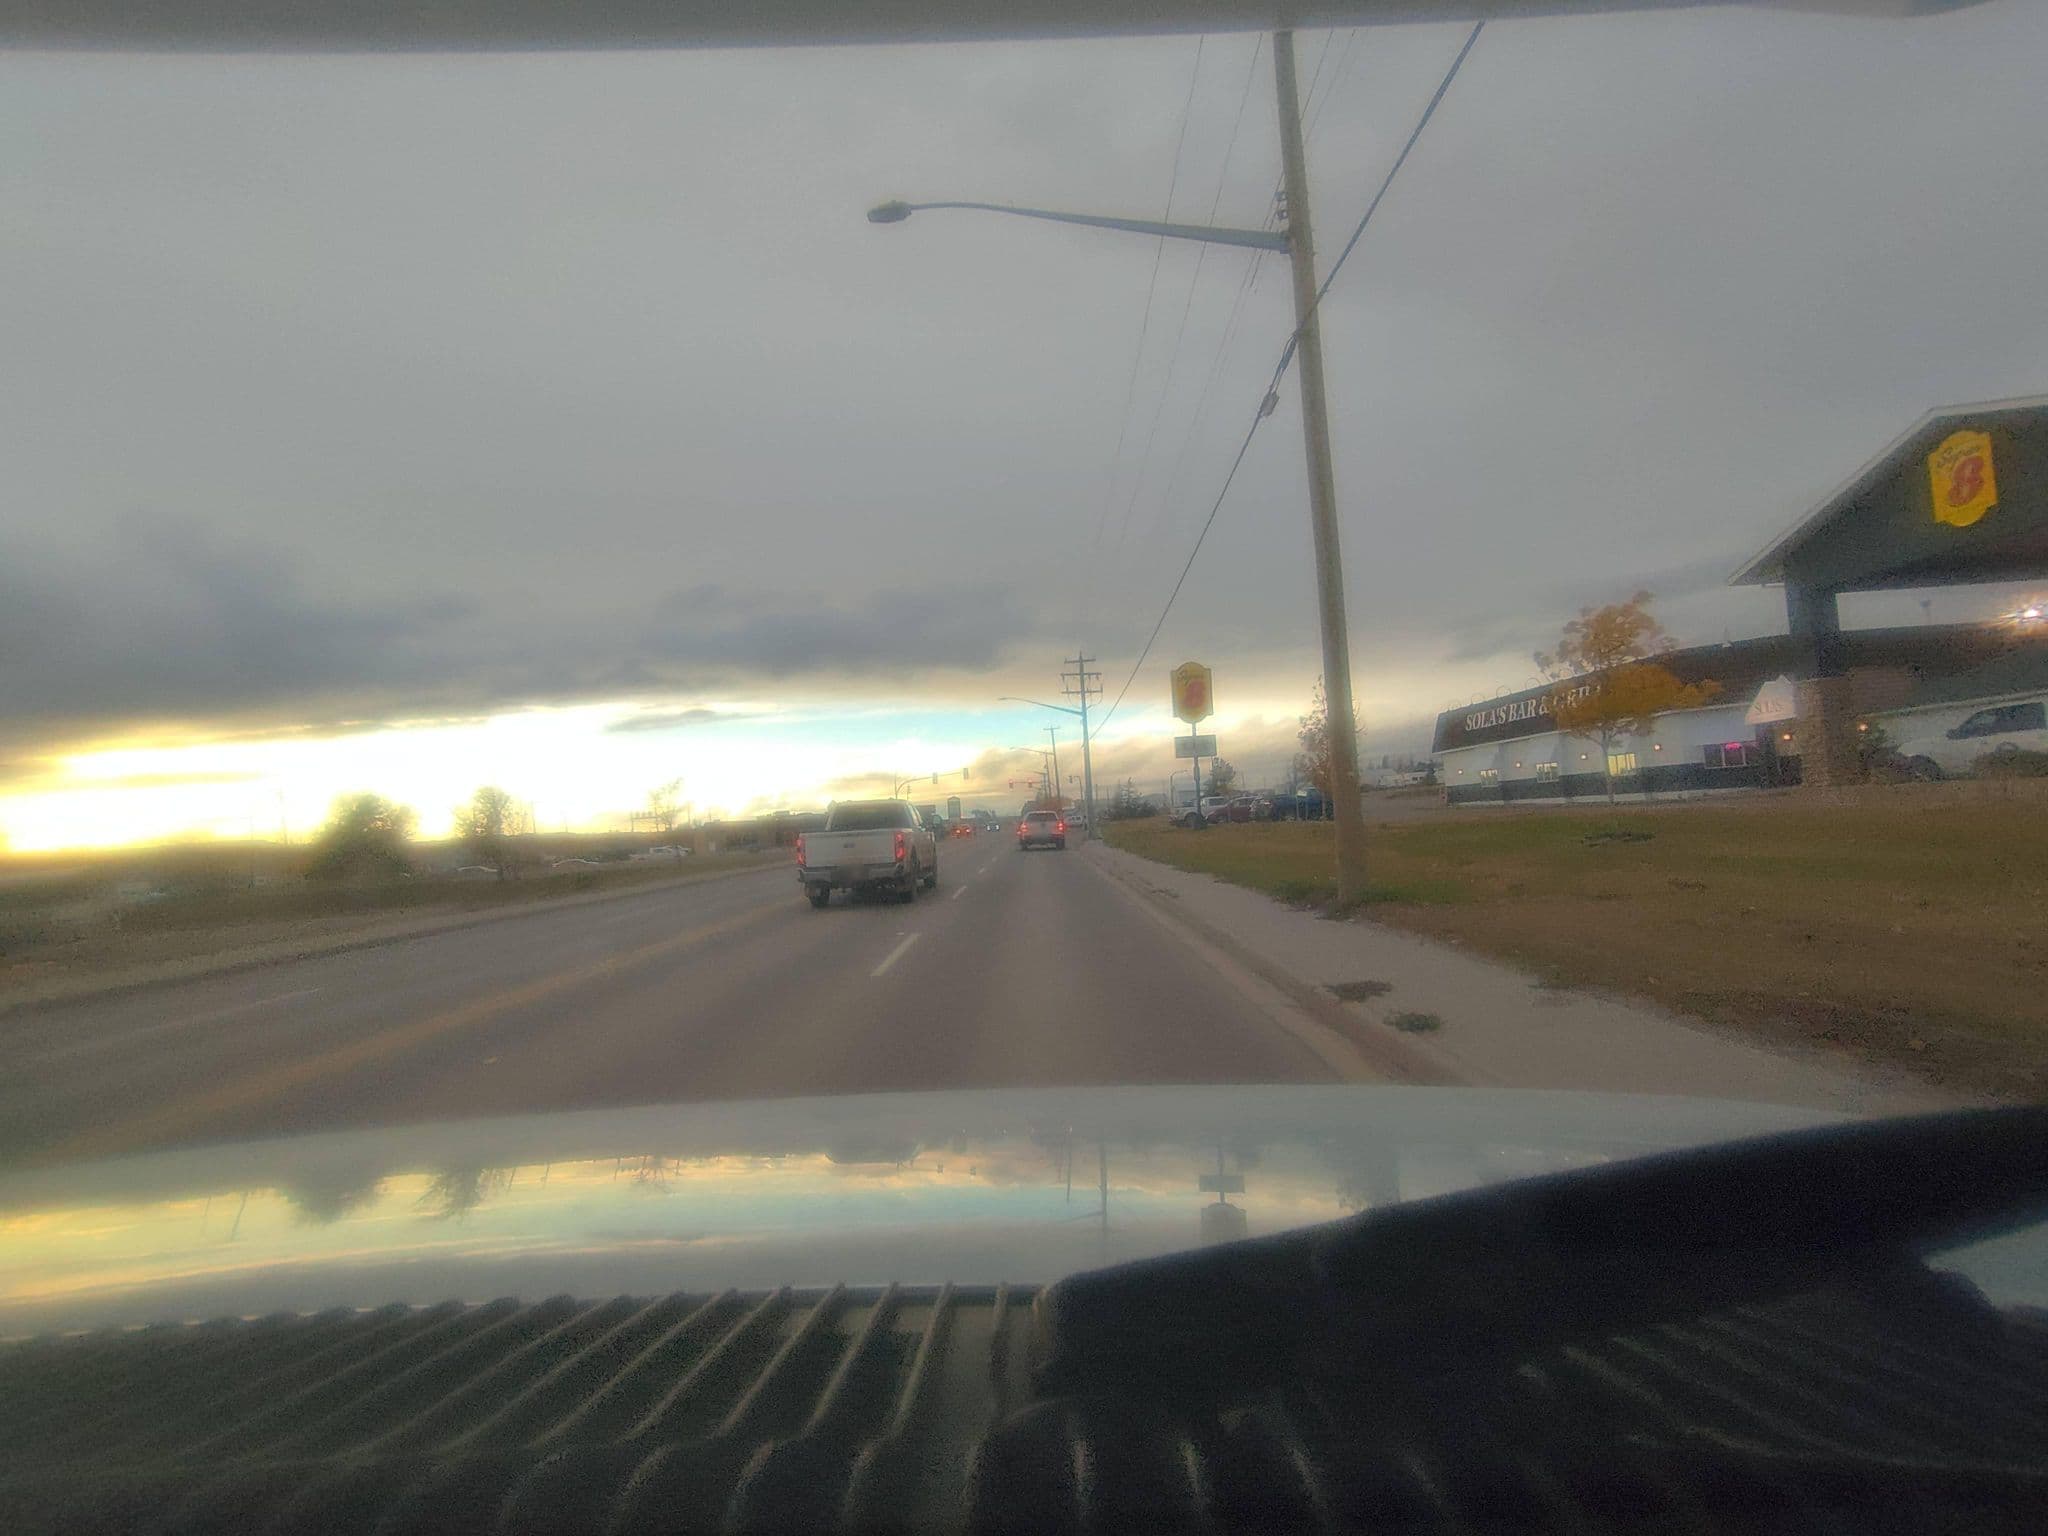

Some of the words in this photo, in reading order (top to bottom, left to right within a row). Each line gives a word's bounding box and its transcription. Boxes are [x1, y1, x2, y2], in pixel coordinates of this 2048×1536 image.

[1948, 455, 1985, 506] 8
[1465, 706, 1507, 731] SOLA'S
[1508, 699, 1537, 723] BAR
